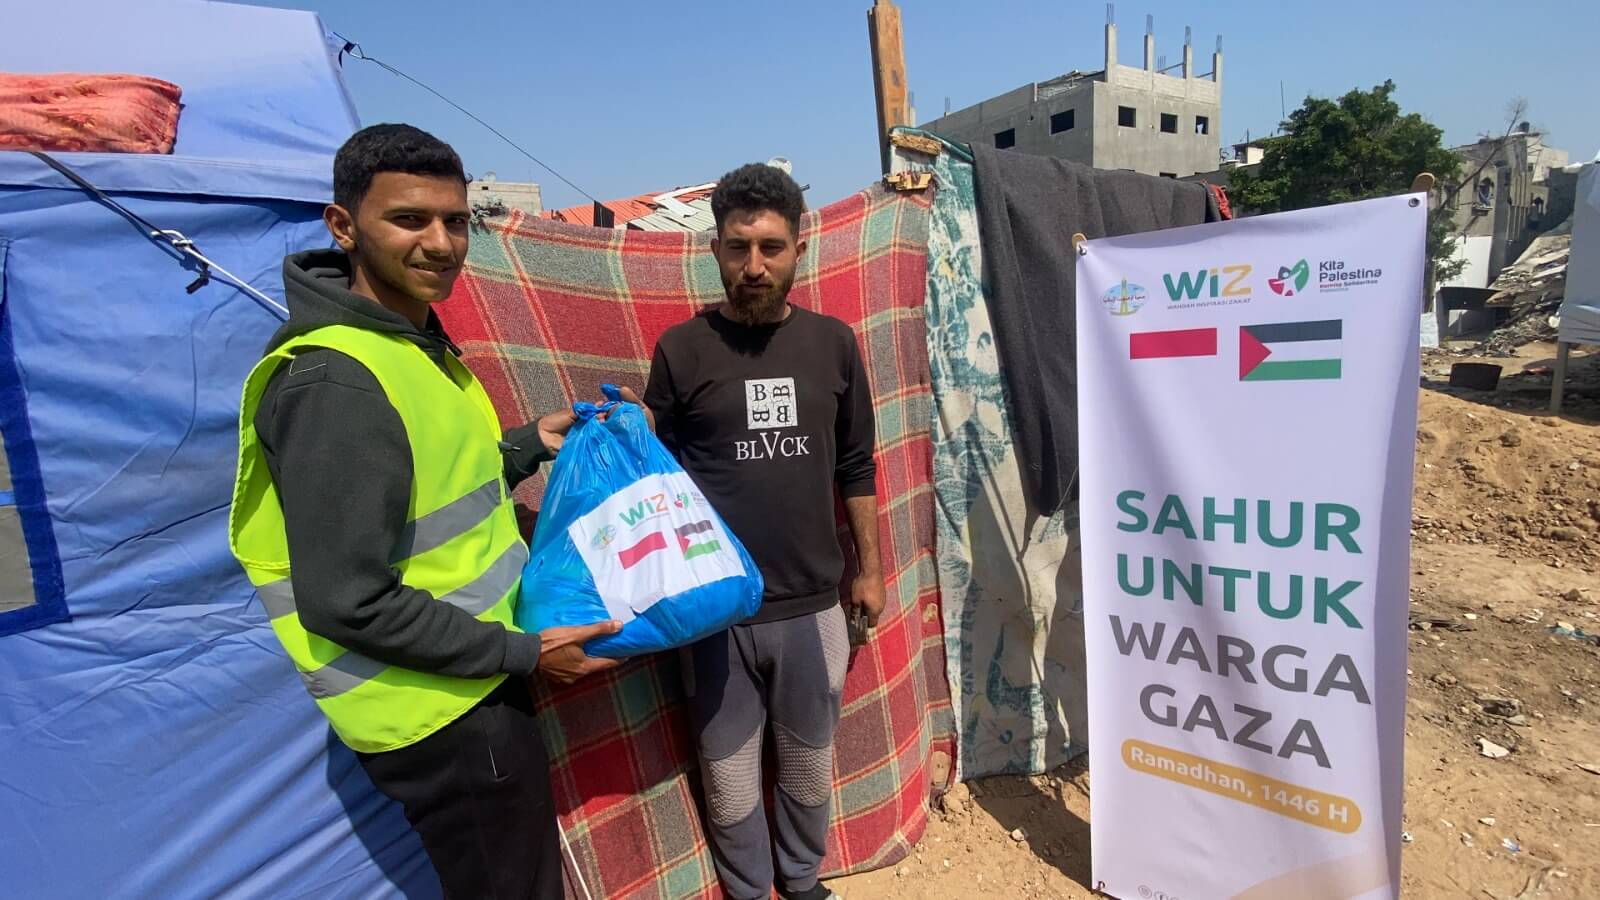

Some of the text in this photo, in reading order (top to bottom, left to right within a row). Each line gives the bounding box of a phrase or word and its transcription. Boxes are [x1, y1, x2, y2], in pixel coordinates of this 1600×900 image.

[1163, 265, 1252, 301] WiZ
[1319, 260, 1345, 272] Kita
[1319, 268, 1382, 283] Palestina
[734, 431, 810, 461] BLVCK
[1116, 489, 1363, 554] SAHUR
[1116, 553, 1364, 630] UNTUK
[1108, 614, 1372, 705] WARGA
[1139, 683, 1332, 769] GAZA
[1130, 746, 1348, 824] Ramadhan, 1446 H
